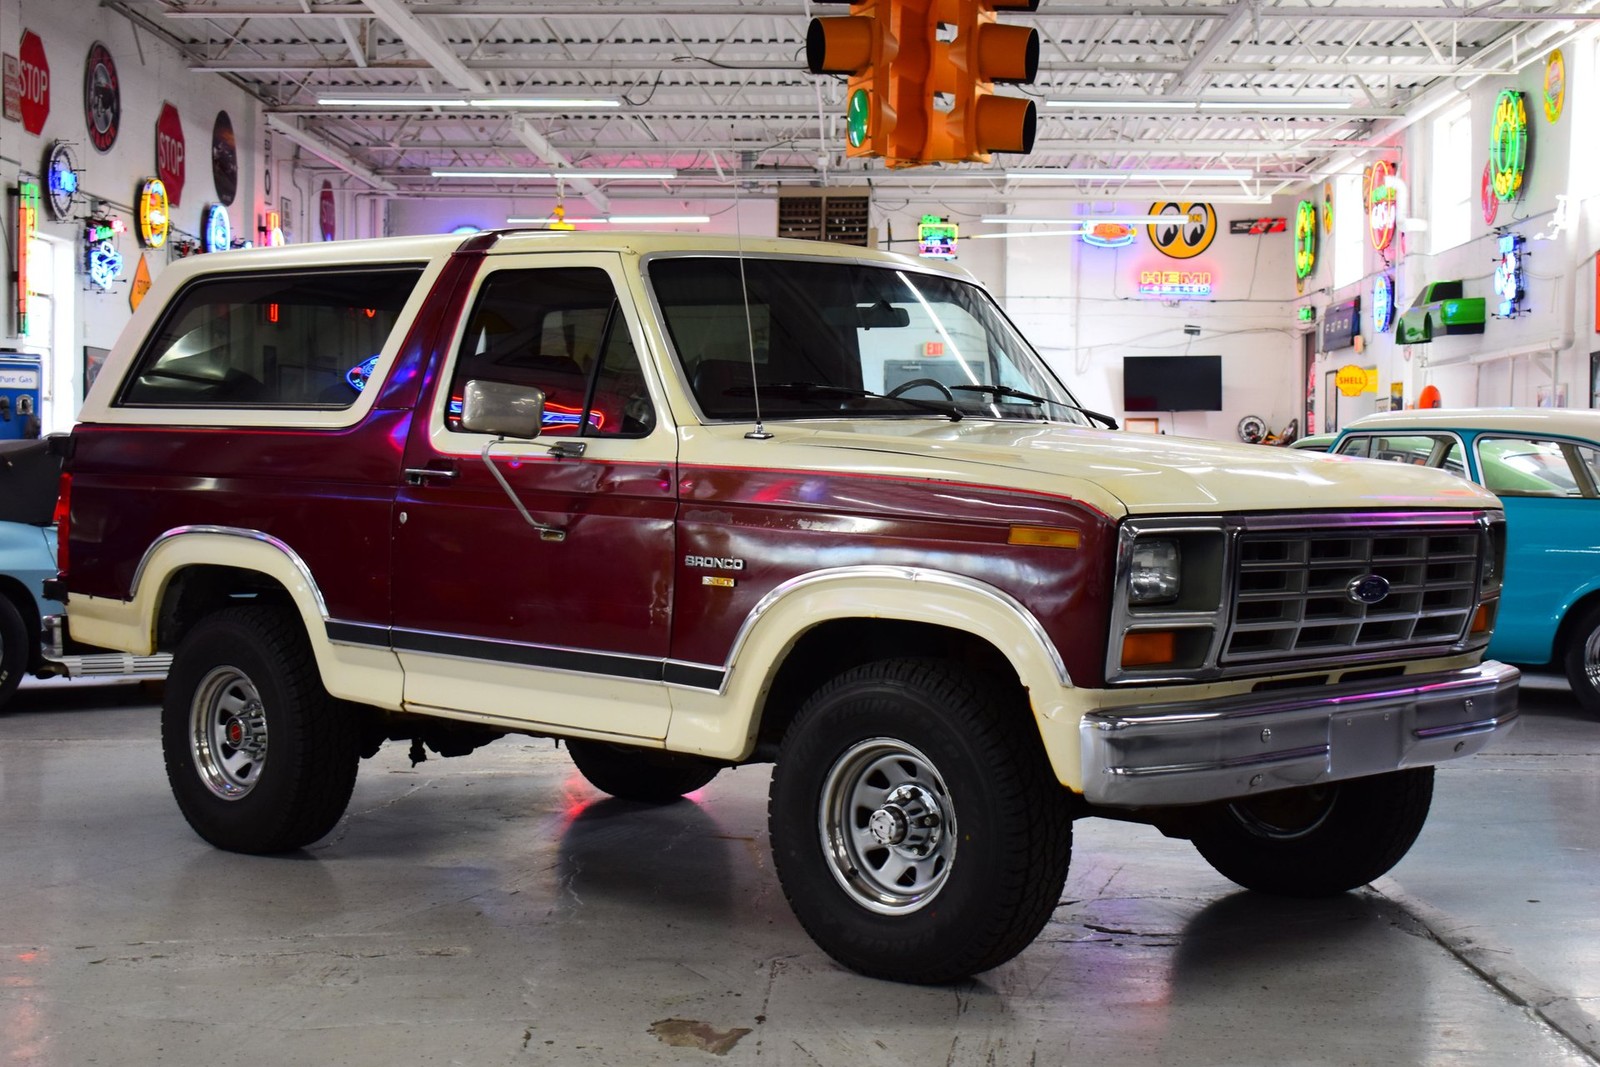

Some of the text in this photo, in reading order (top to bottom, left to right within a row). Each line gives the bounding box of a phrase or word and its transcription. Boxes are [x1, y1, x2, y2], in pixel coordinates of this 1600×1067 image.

[20, 60, 48, 105] STOP
[160, 132, 184, 176] STOP
[1141, 271, 1211, 284] HEMI
[1325, 318, 1349, 334] FORD
[1340, 377, 1363, 385] SHELL
[684, 555, 745, 571] BRONCO
[706, 577, 732, 586] XLT
